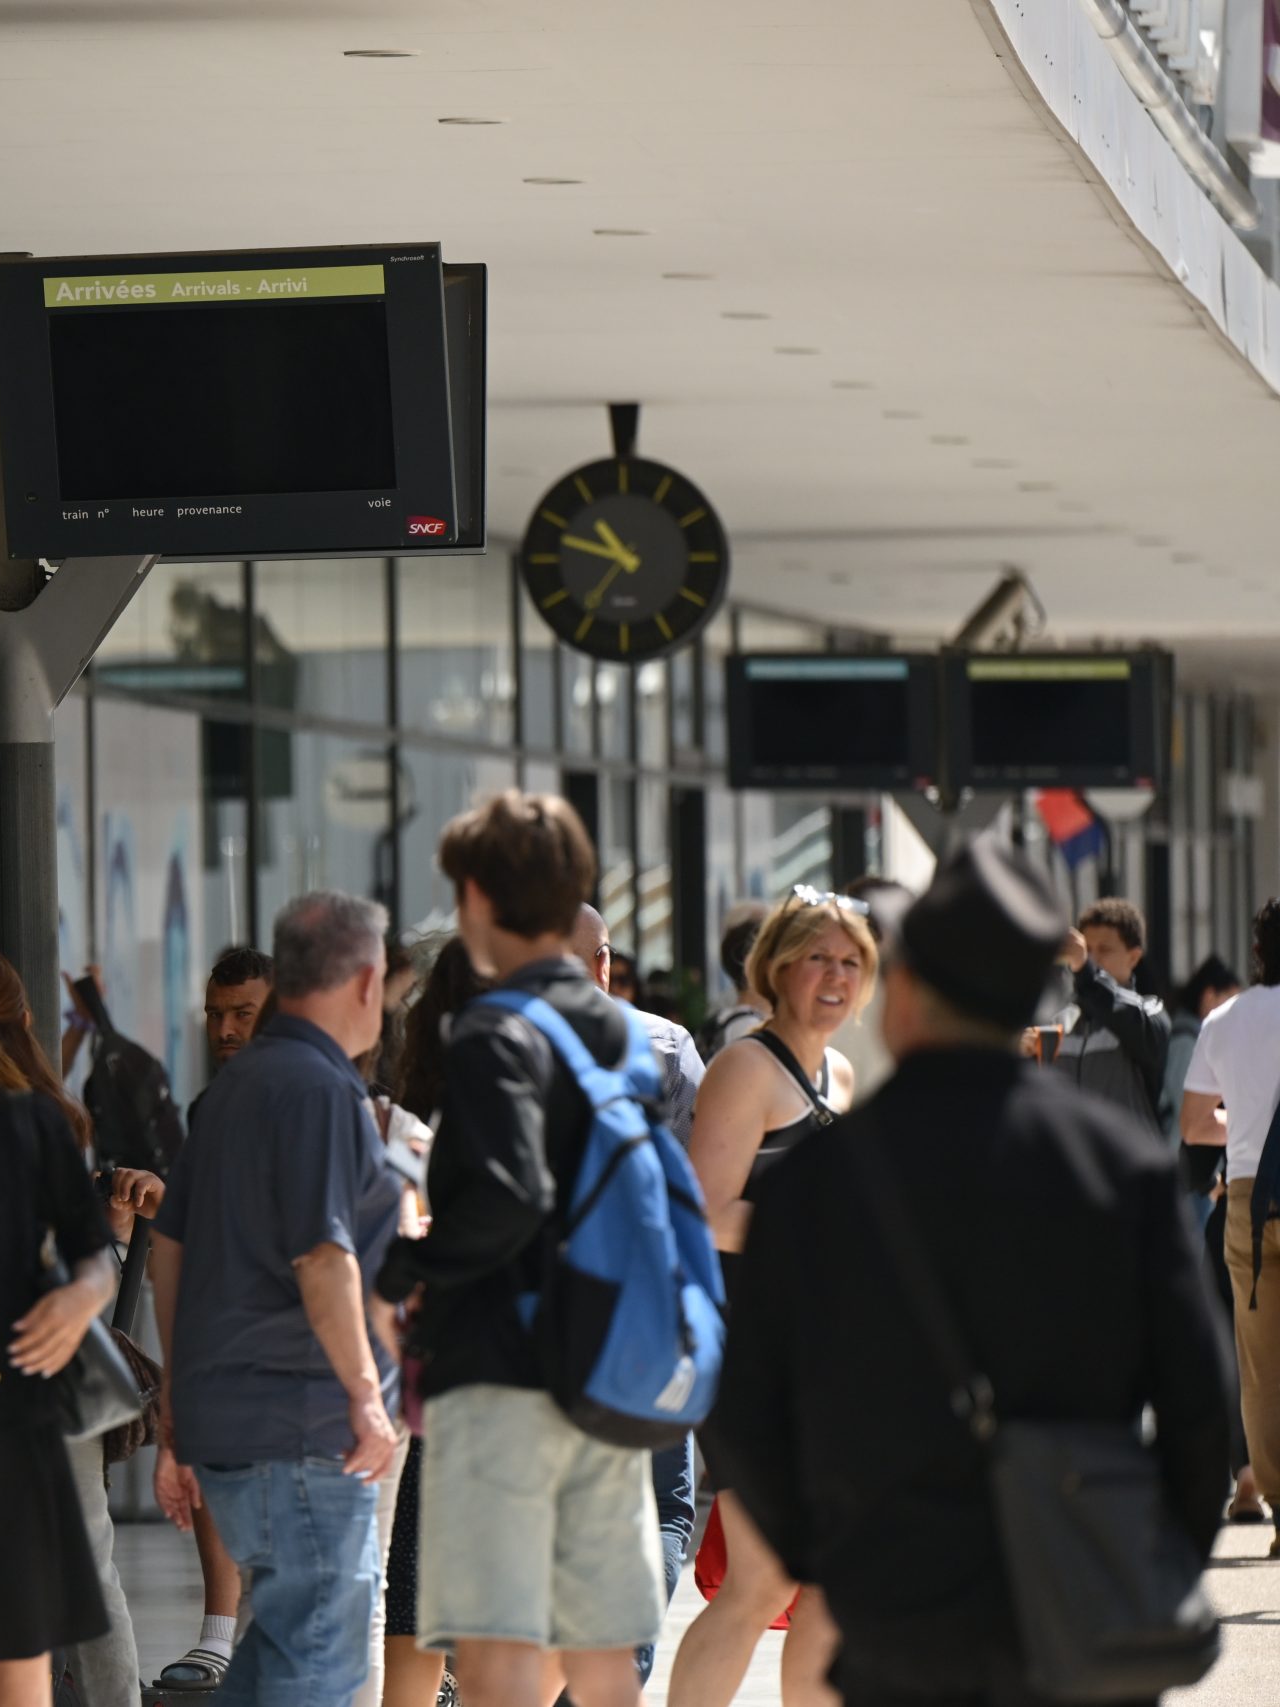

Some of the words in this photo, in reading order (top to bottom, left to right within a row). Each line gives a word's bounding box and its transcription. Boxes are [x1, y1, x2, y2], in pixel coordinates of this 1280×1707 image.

[56, 280, 156, 301] Arrivées
[171, 280, 241, 297] Arrivals
[256, 277, 308, 294] Arrivi
[367, 497, 391, 508] voie
[62, 509, 89, 520] train
[97, 508, 110, 518] n°
[132, 507, 164, 517] heure
[177, 505, 242, 518] provenance
[408, 523, 444, 534] SNCF
